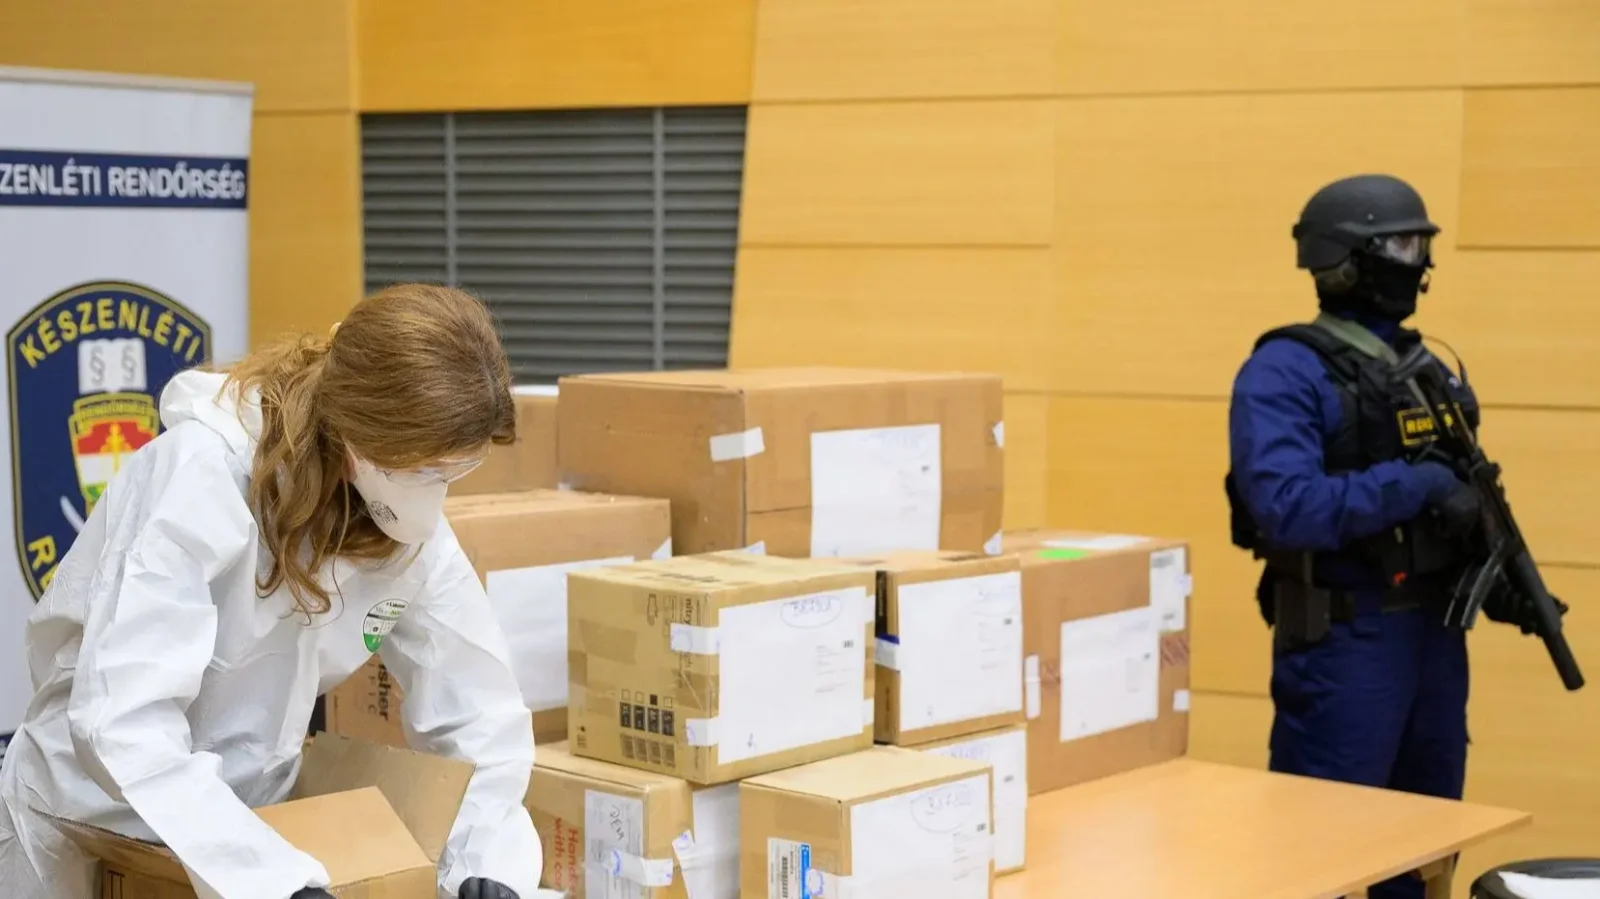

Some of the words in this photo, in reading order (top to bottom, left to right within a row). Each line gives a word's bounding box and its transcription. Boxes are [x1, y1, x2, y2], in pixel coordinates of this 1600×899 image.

[0, 157, 101, 196] ZENLÉTI
[108, 161, 246, 199] RENDŐRSÉG
[19, 298, 201, 368] KÉSZENLÉTI
[555, 818, 565, 857] with
